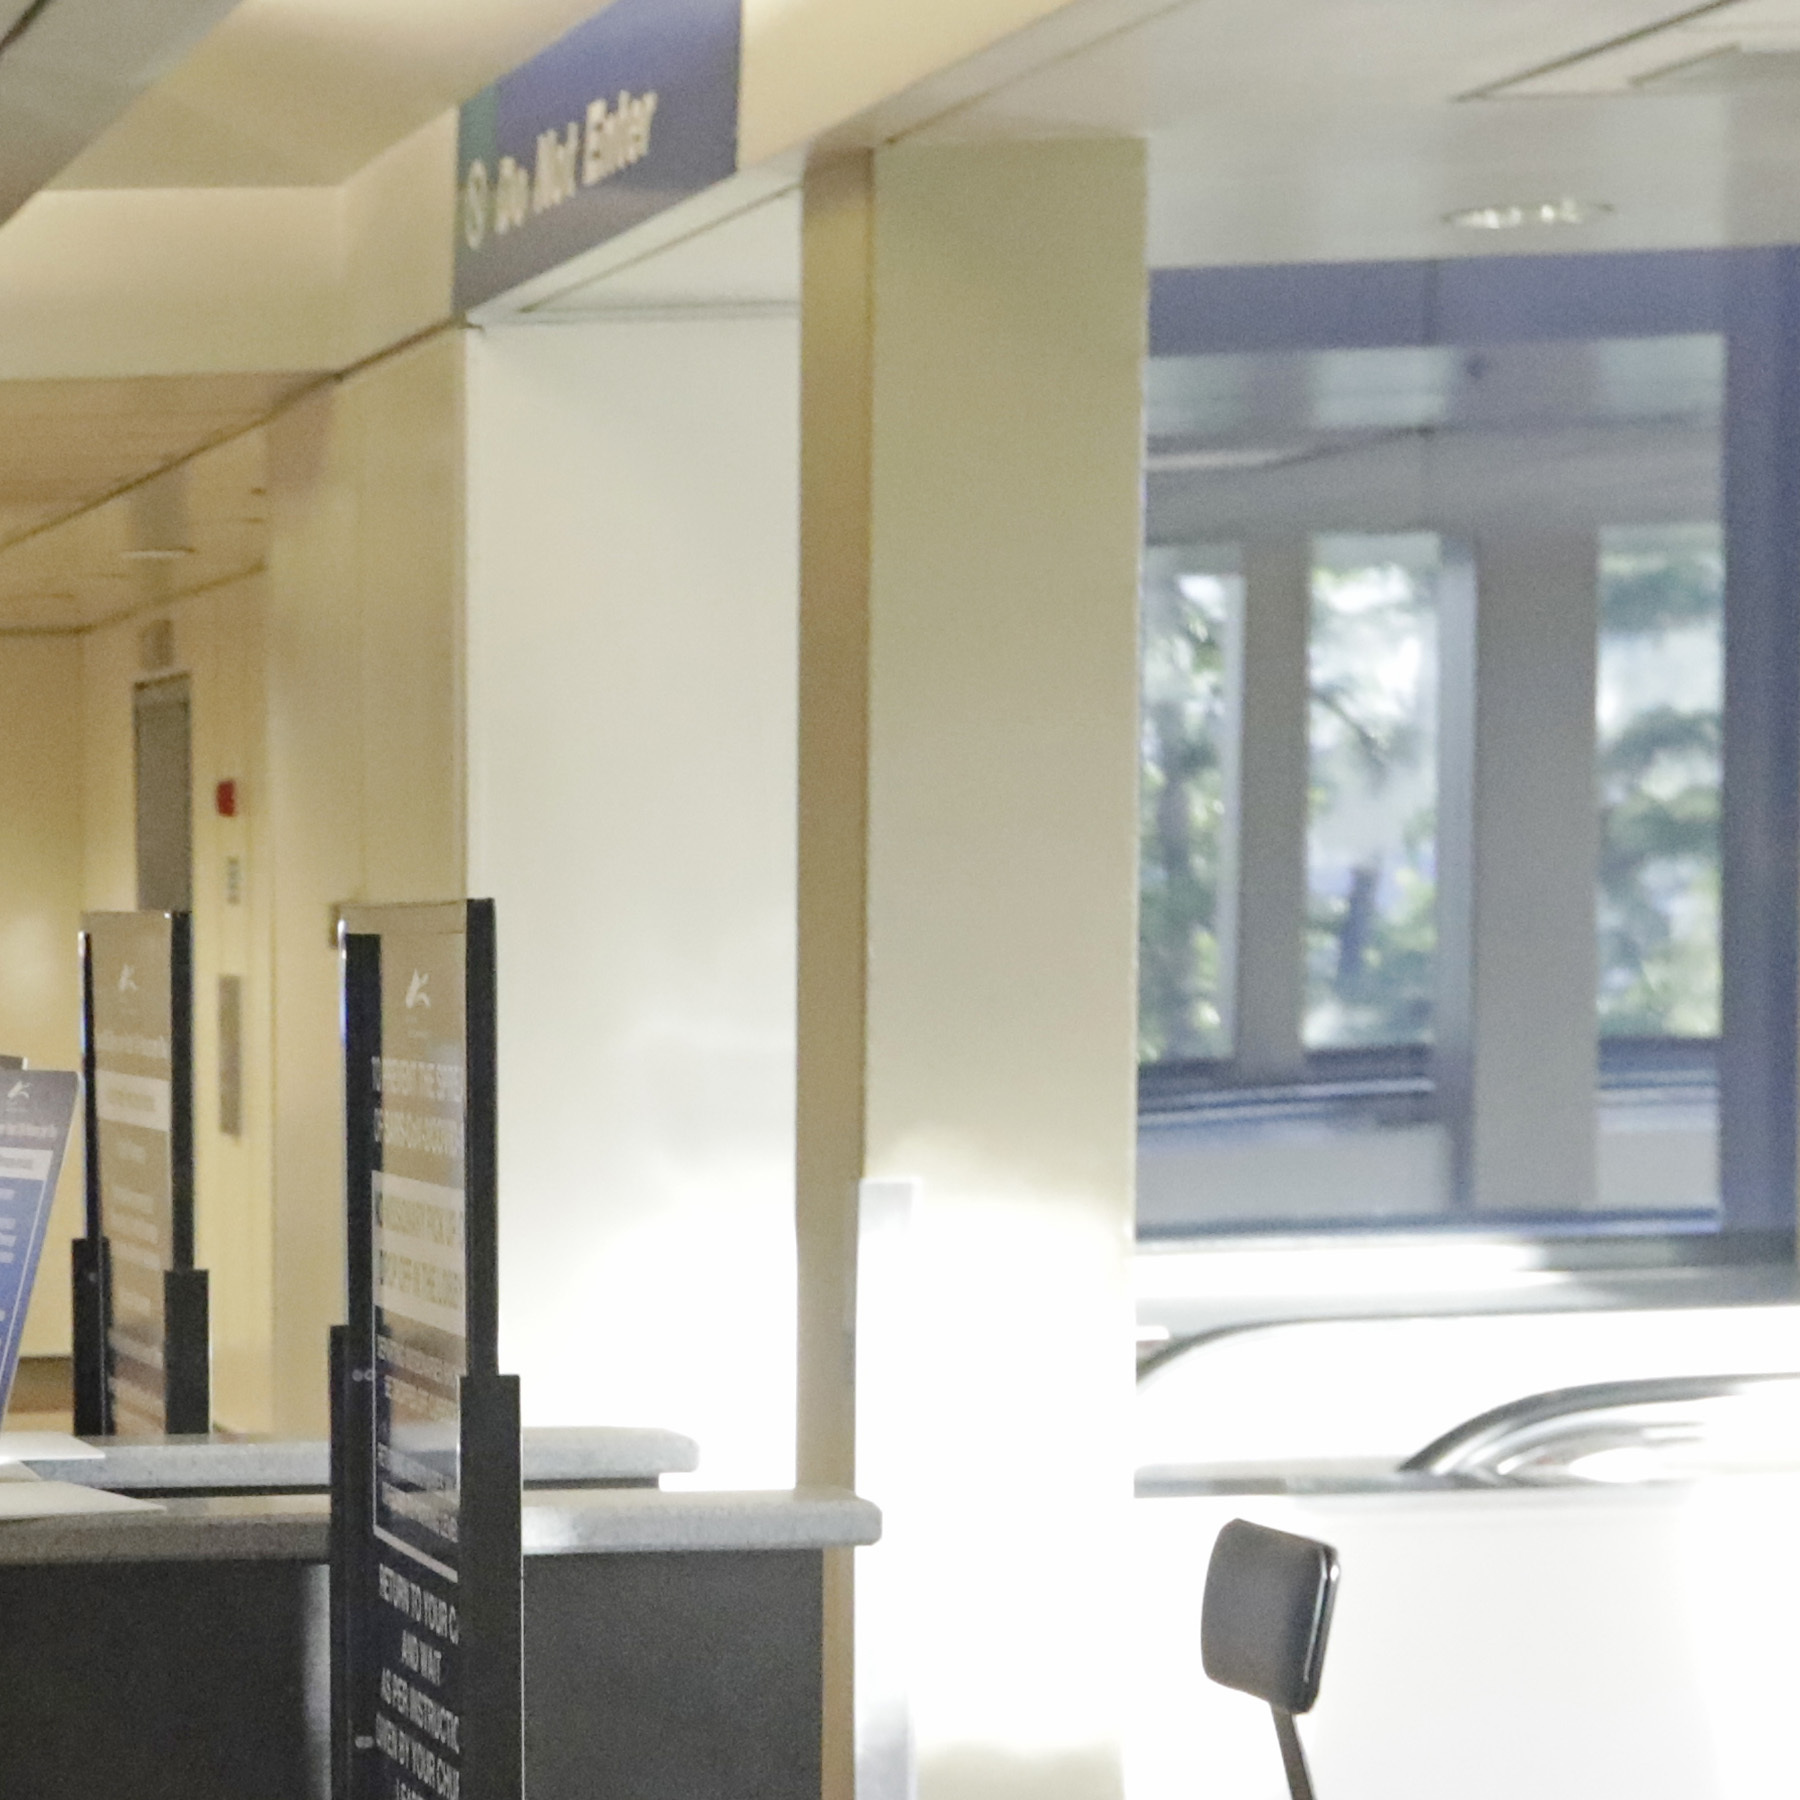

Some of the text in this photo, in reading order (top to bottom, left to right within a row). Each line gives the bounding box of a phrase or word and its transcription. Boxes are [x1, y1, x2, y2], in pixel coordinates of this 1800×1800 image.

[582, 88, 659, 187] Enter
[379, 1563, 409, 1614] RETURN
[410, 1582, 421, 1622] TO
[423, 1590, 448, 1638] YOUR
[402, 1629, 442, 1688] AND WAIT
[381, 1667, 392, 1705] AS
[393, 1673, 408, 1718] PER
[399, 1730, 410, 1769] BY
[412, 1740, 436, 1789] YOUR
